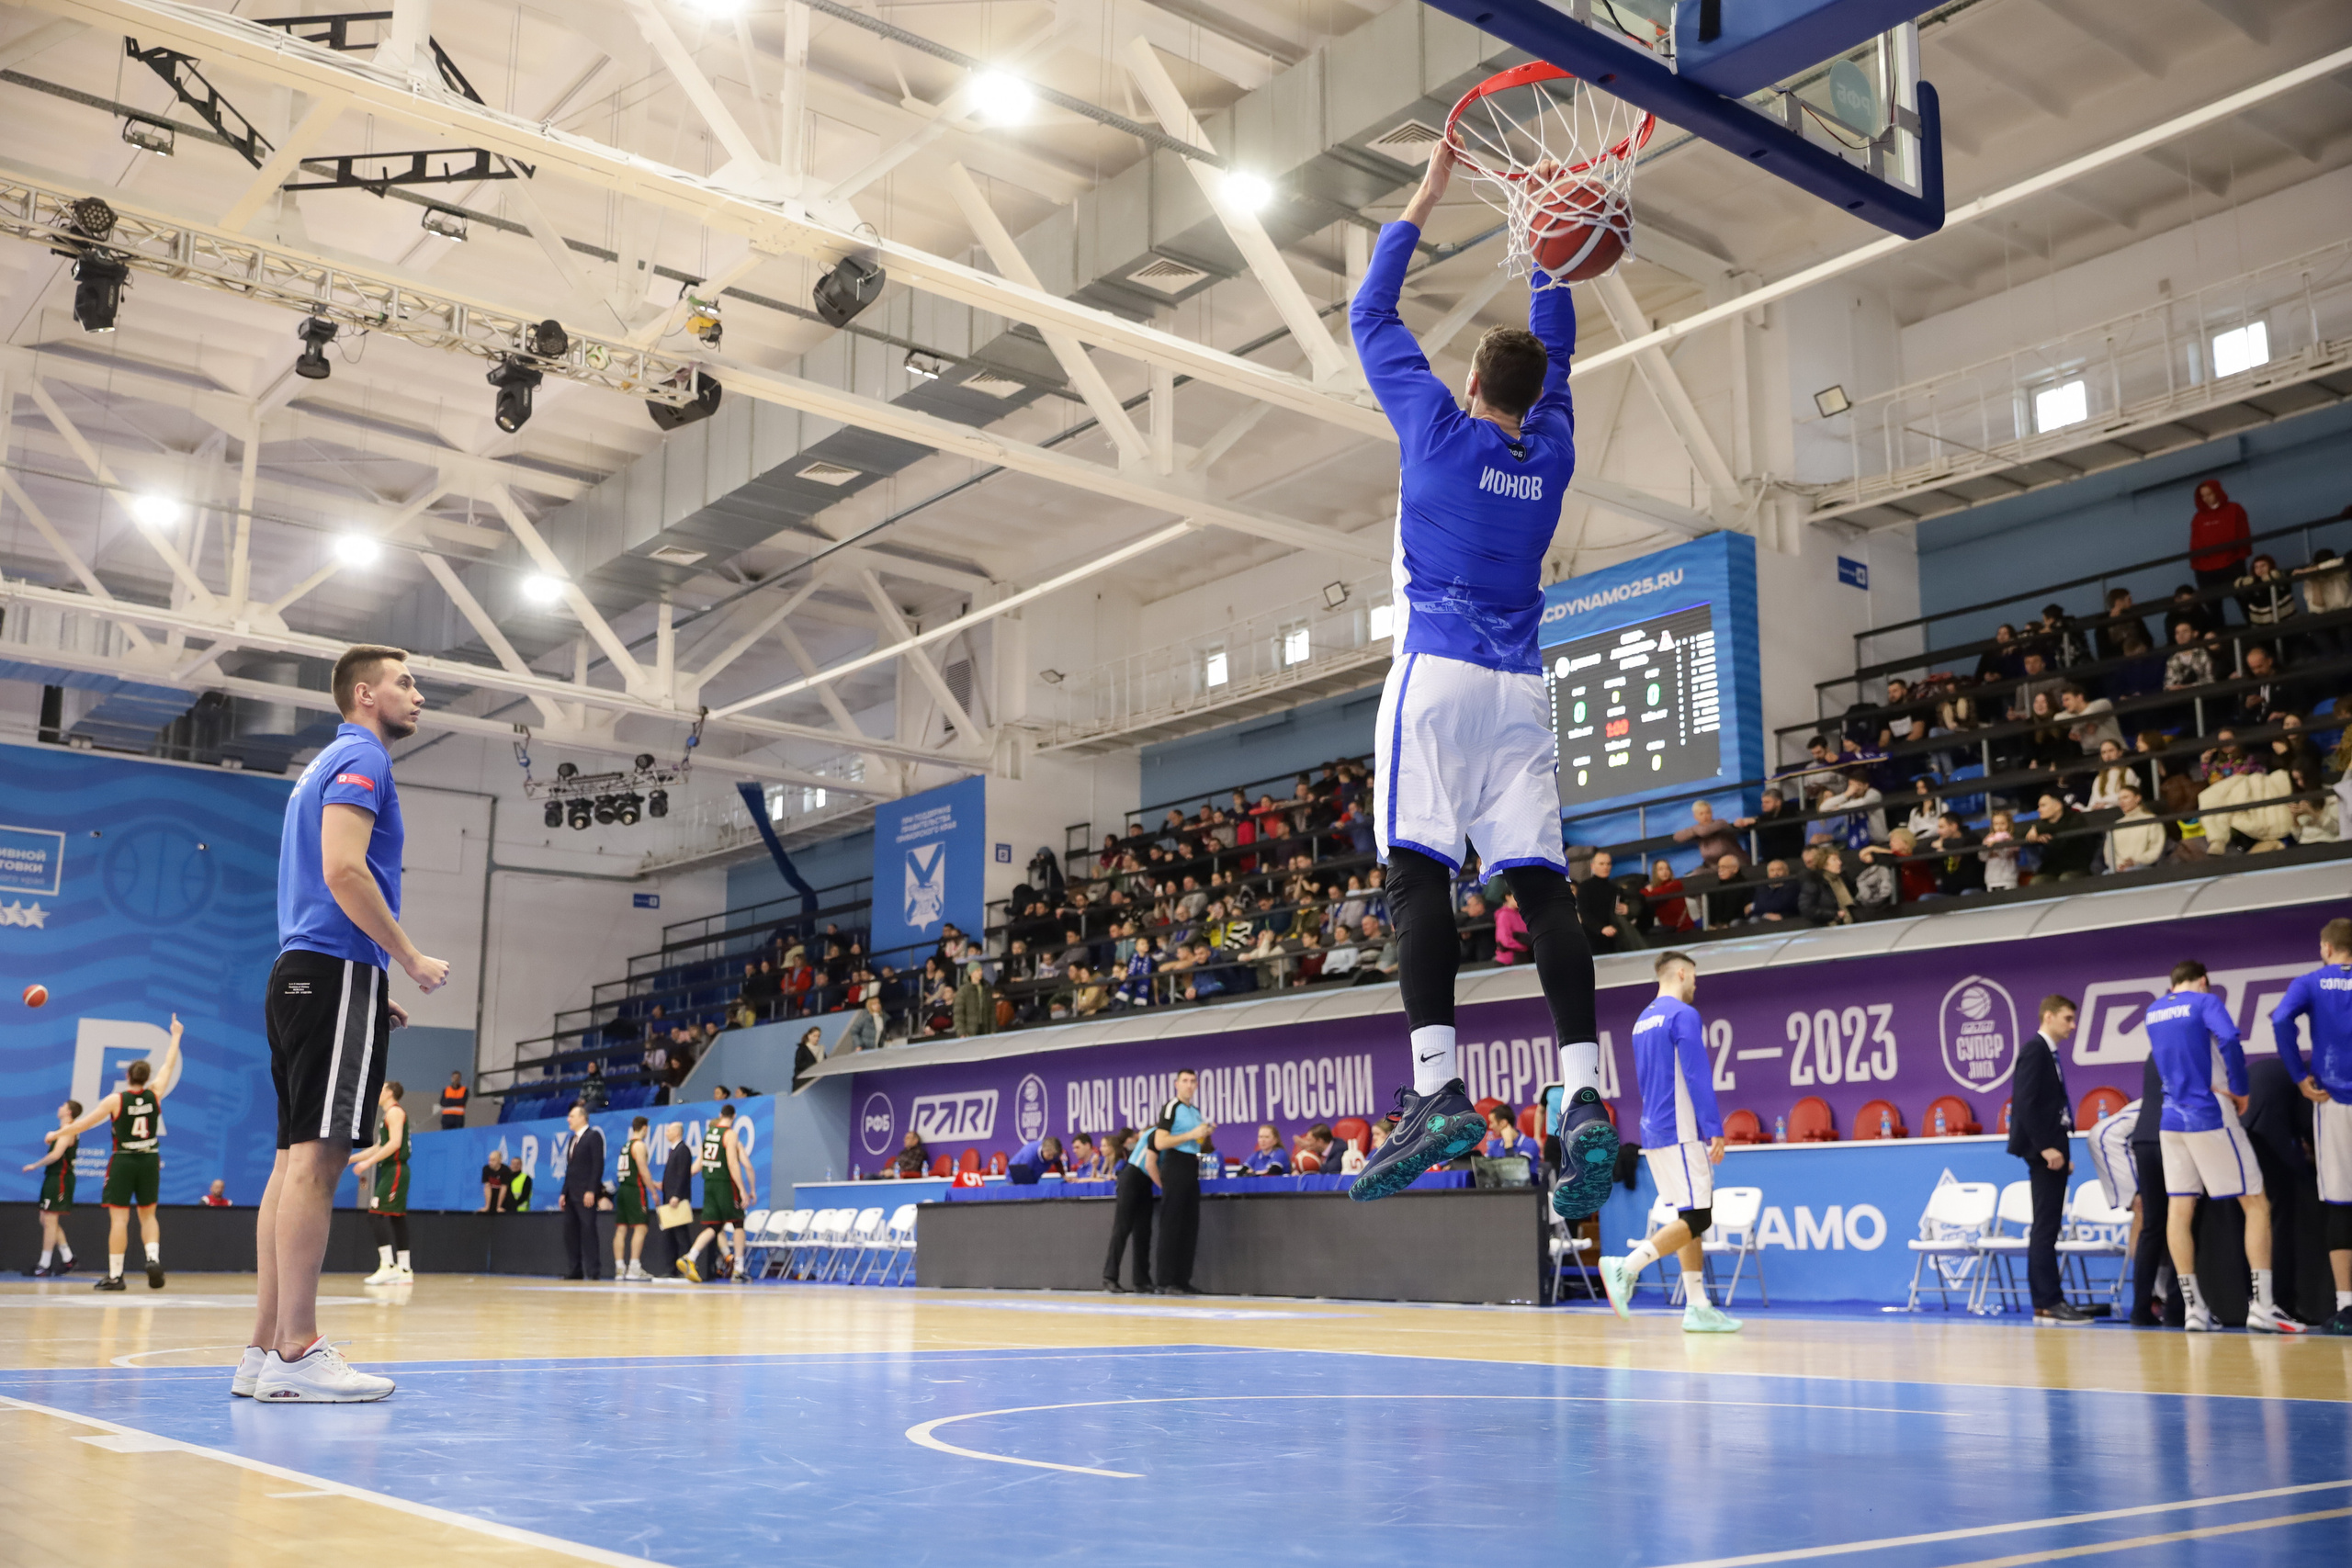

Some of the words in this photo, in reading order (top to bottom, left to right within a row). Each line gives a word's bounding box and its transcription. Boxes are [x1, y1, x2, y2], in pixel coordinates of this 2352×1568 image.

[1478, 465, 1544, 502] ИОНОВ
[1539, 568, 1684, 626] CDYNAMO25.RU
[1067, 1078, 1114, 1134] PARI
[1118, 1064, 1260, 1131] ЧЕМПОНАТ
[1265, 1054, 1374, 1122] РОССИИ
[131, 1115, 148, 1138] 4
[865, 1114, 890, 1133] РФБ
[704, 1143, 719, 1160] 27
